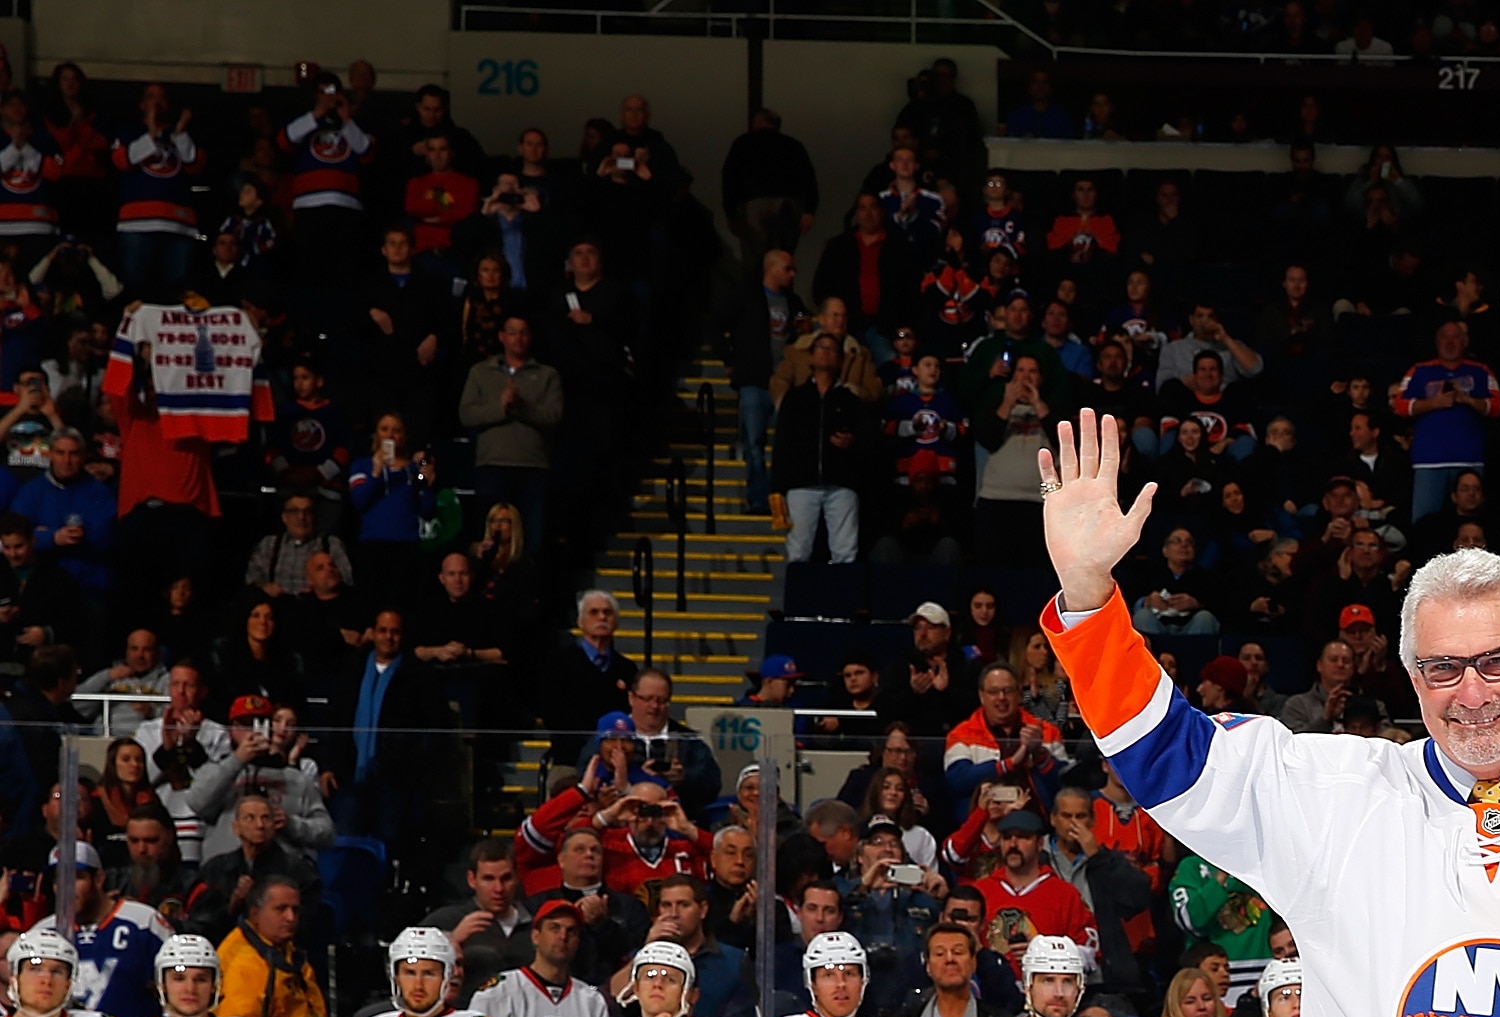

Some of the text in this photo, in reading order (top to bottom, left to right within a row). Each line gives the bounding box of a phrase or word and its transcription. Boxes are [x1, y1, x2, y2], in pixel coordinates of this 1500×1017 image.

[227, 67, 257, 91] EXIT
[478, 60, 539, 96] 216
[1438, 66, 1481, 91] 217
[186, 374, 224, 388] BEST
[714, 716, 761, 752] 116
[675, 853, 693, 875] C
[112, 925, 130, 950] C
